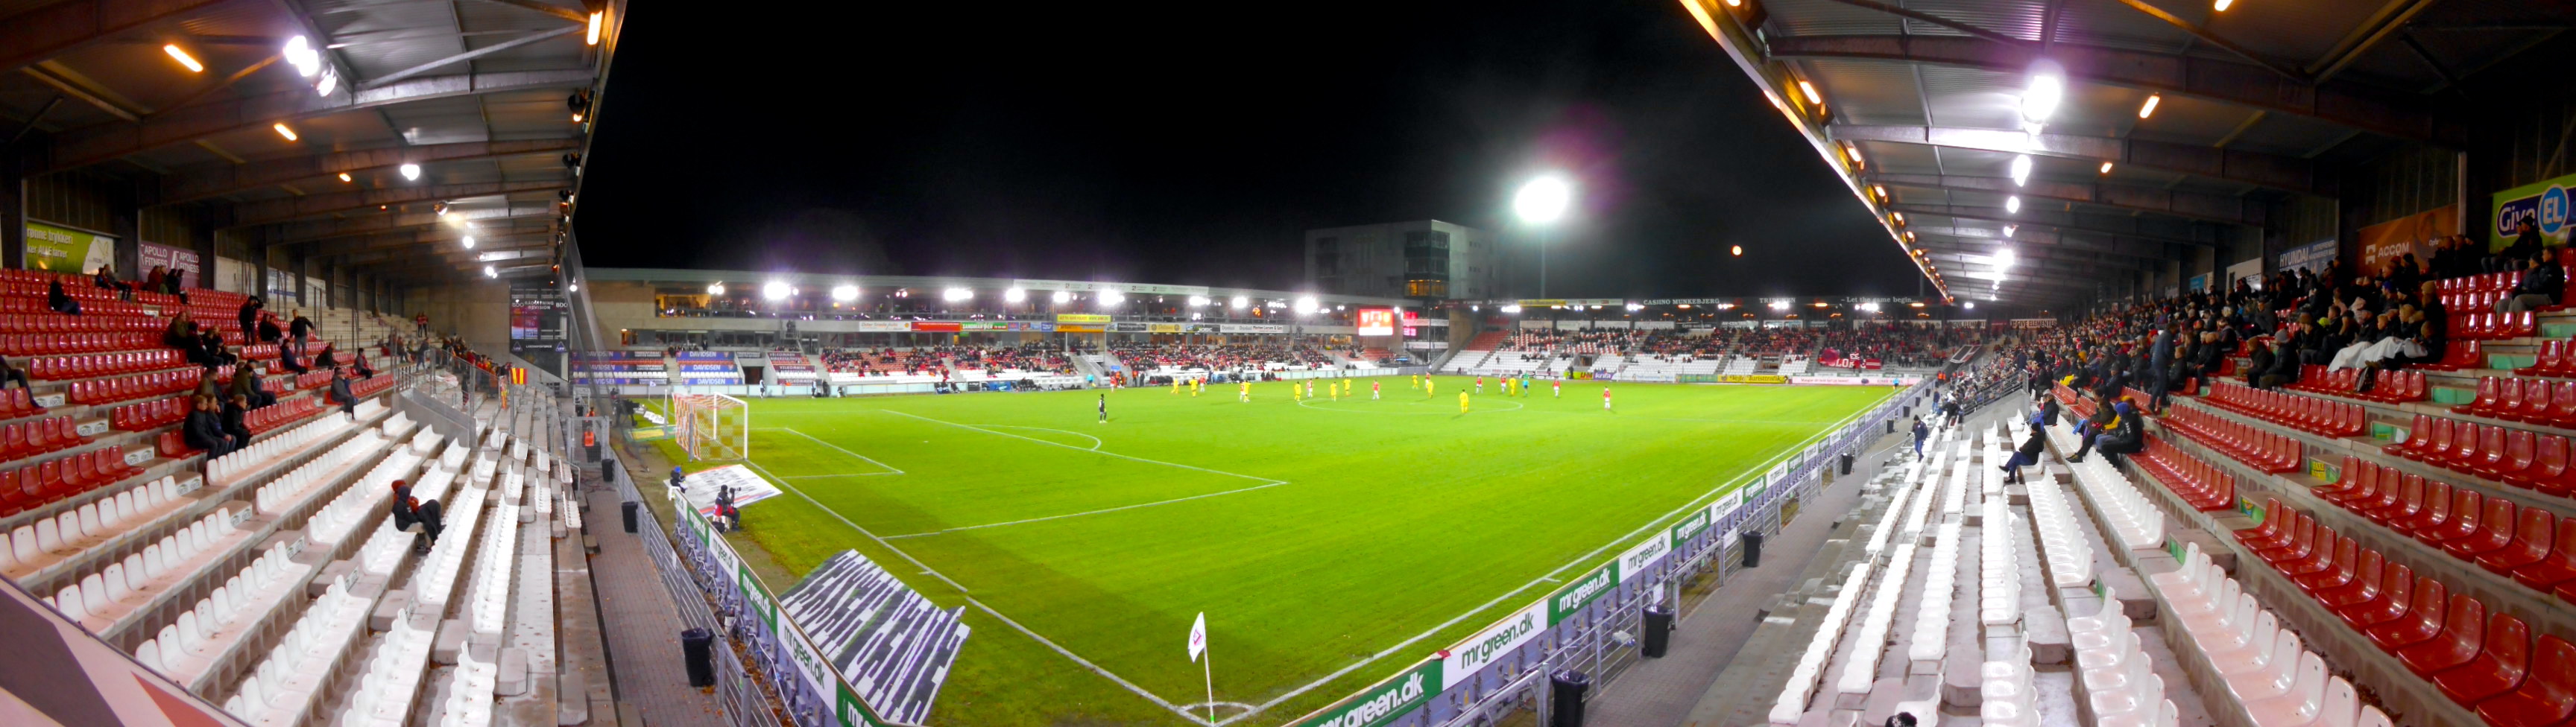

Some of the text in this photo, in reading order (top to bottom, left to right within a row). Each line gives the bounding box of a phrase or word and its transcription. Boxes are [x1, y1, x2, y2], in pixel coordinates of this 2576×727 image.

[2542, 196, 2563, 225] EL
[144, 245, 168, 258] APOLLO
[180, 252, 199, 264] APOLLO
[2279, 247, 2308, 267] HYUNDAI
[2378, 241, 2410, 258] ACCOM
[180, 262, 199, 274] FITNESS
[1461, 612, 1534, 670] mr green.dk
[1344, 671, 1424, 727] green.dk
